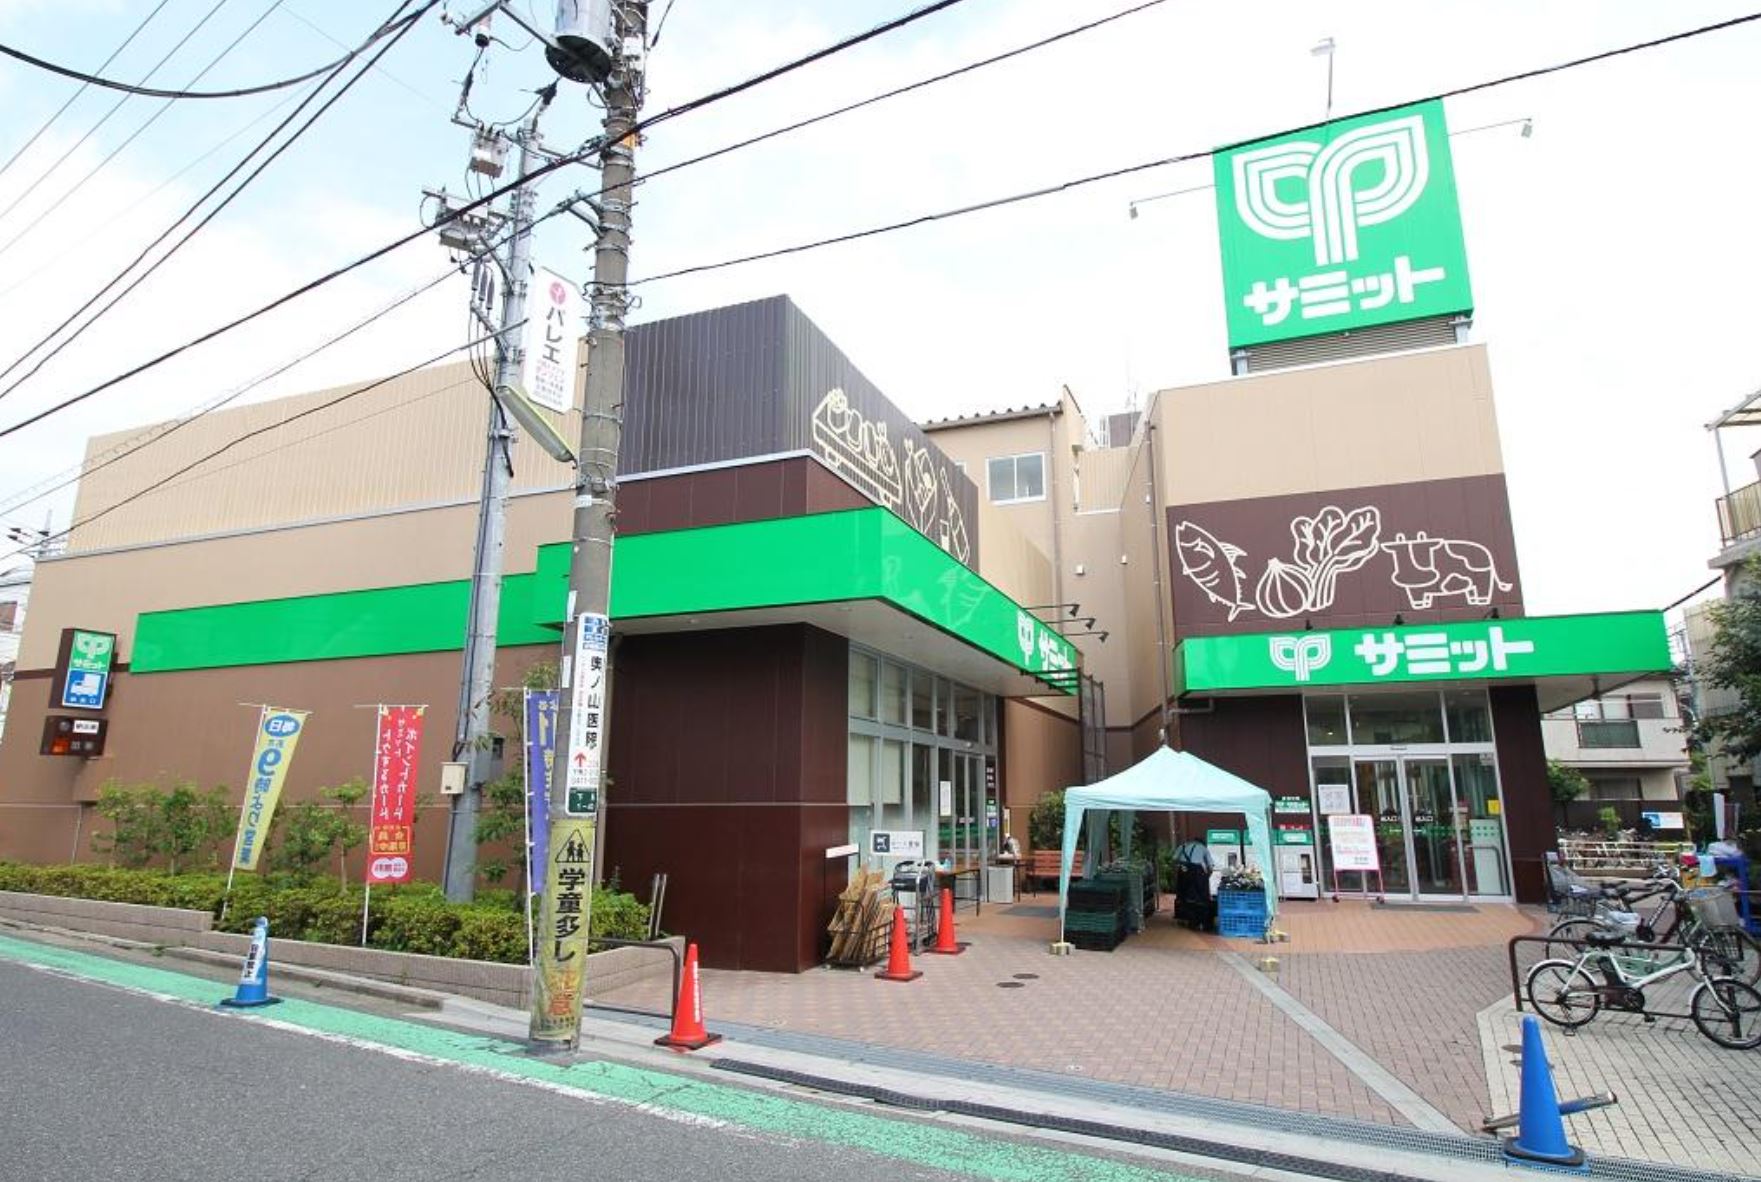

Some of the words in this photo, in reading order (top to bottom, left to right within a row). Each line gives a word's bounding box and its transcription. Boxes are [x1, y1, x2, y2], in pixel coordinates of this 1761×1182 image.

[1243, 255, 1445, 326] サミット
[542, 306, 566, 364] バレエ
[1354, 626, 1535, 676] サミット
[554, 867, 585, 962] 学童多し
